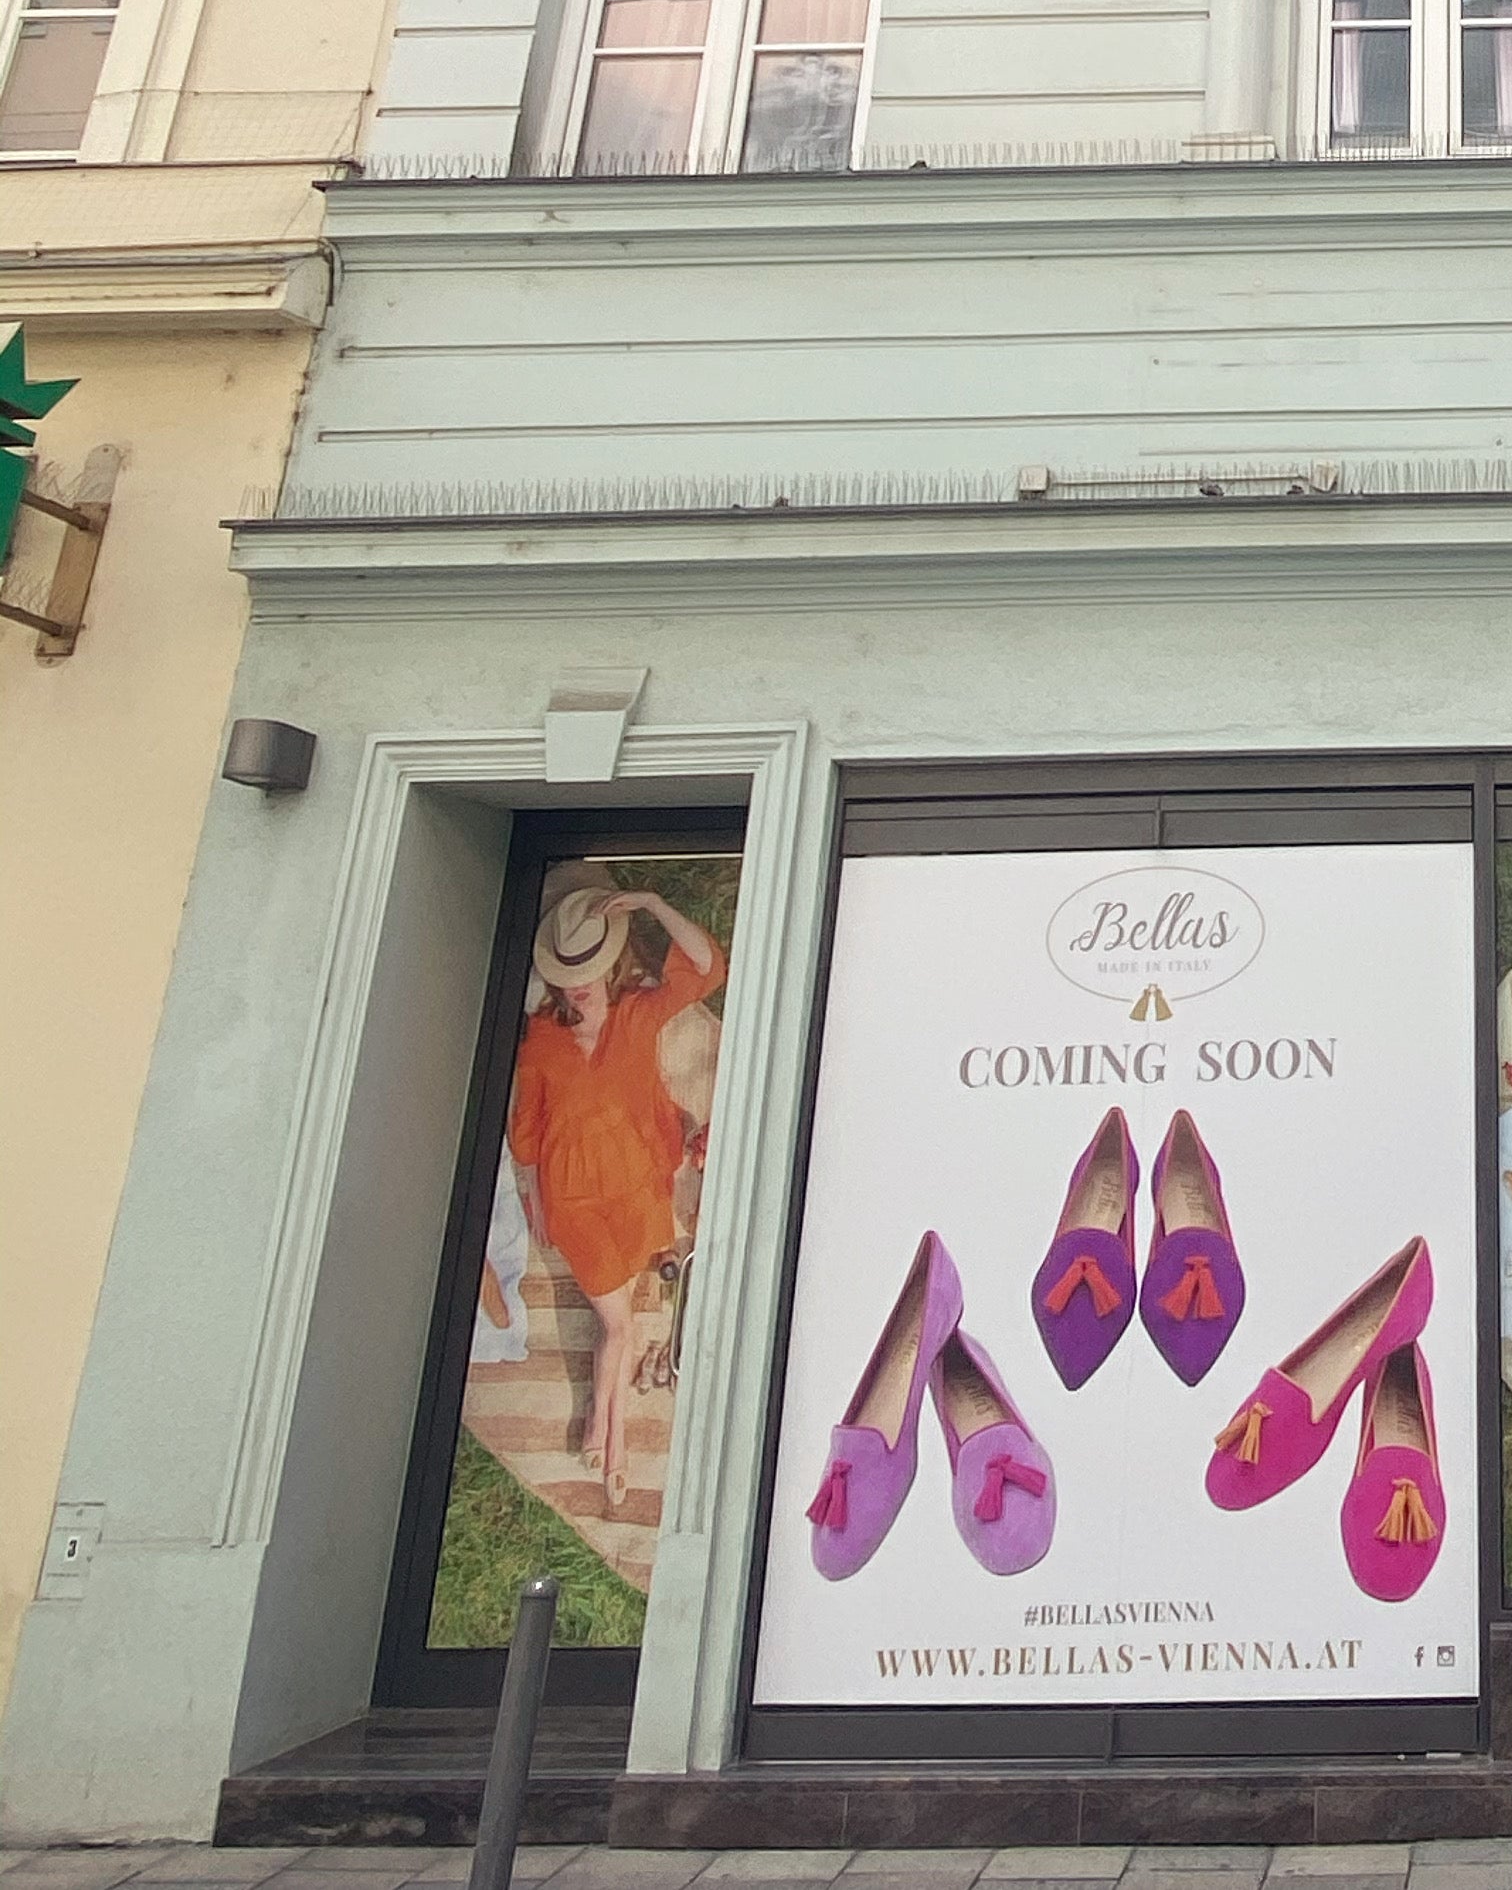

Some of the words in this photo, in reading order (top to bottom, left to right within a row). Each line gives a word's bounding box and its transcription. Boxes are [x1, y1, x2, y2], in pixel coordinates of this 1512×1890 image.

[1069, 891, 1240, 952] Bellas
[1098, 961, 1139, 974] MADE
[1144, 960, 1161, 973] IN
[1168, 959, 1212, 972] ITALY
[958, 1041, 1168, 1089] COMING
[1196, 1037, 1338, 1082] SOON
[1023, 1601, 1216, 1628] #BELLASVIENNA
[875, 1639, 1364, 1679] WWW.BELLAS-VIENNA.AT
